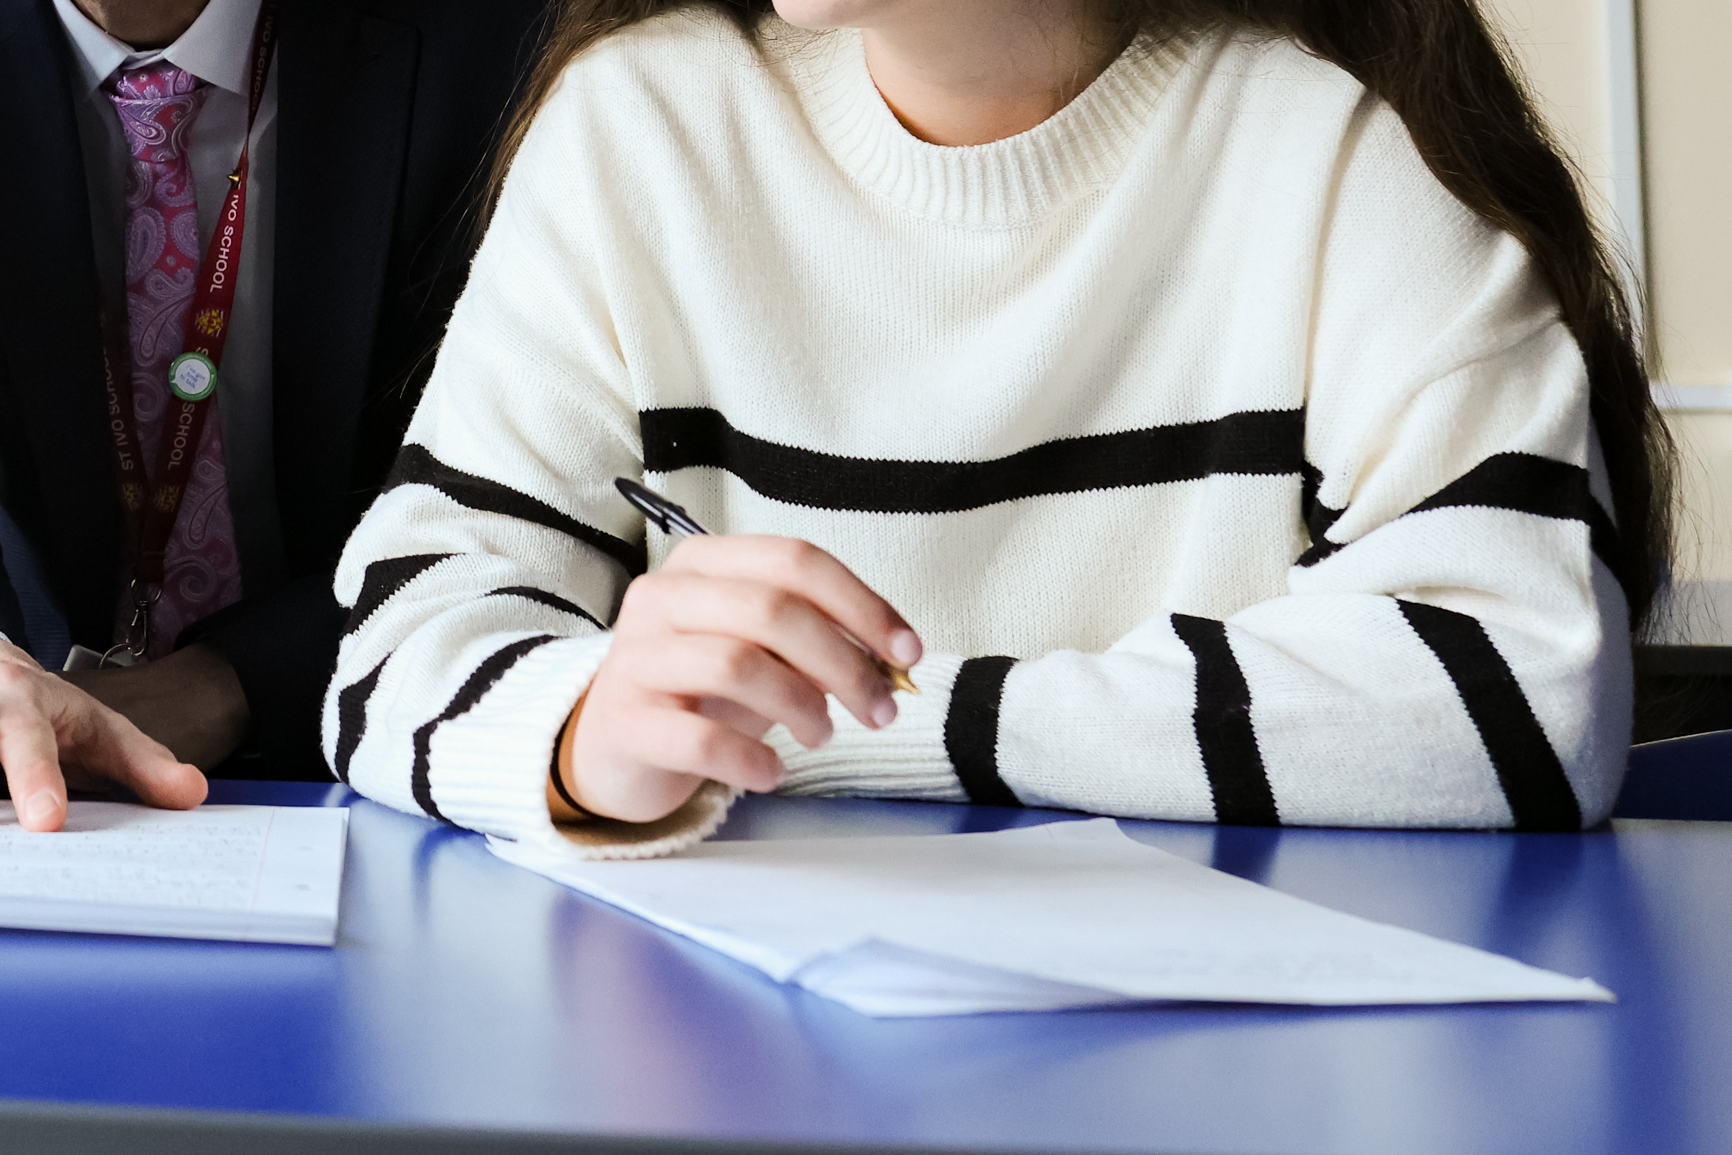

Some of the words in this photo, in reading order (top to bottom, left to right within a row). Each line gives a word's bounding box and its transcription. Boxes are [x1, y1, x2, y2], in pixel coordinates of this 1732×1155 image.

[210, 225, 234, 293] SCHOOL
[111, 418, 128, 446] IVO
[167, 402, 196, 470] SCHOOL
[119, 450, 134, 471] ST
